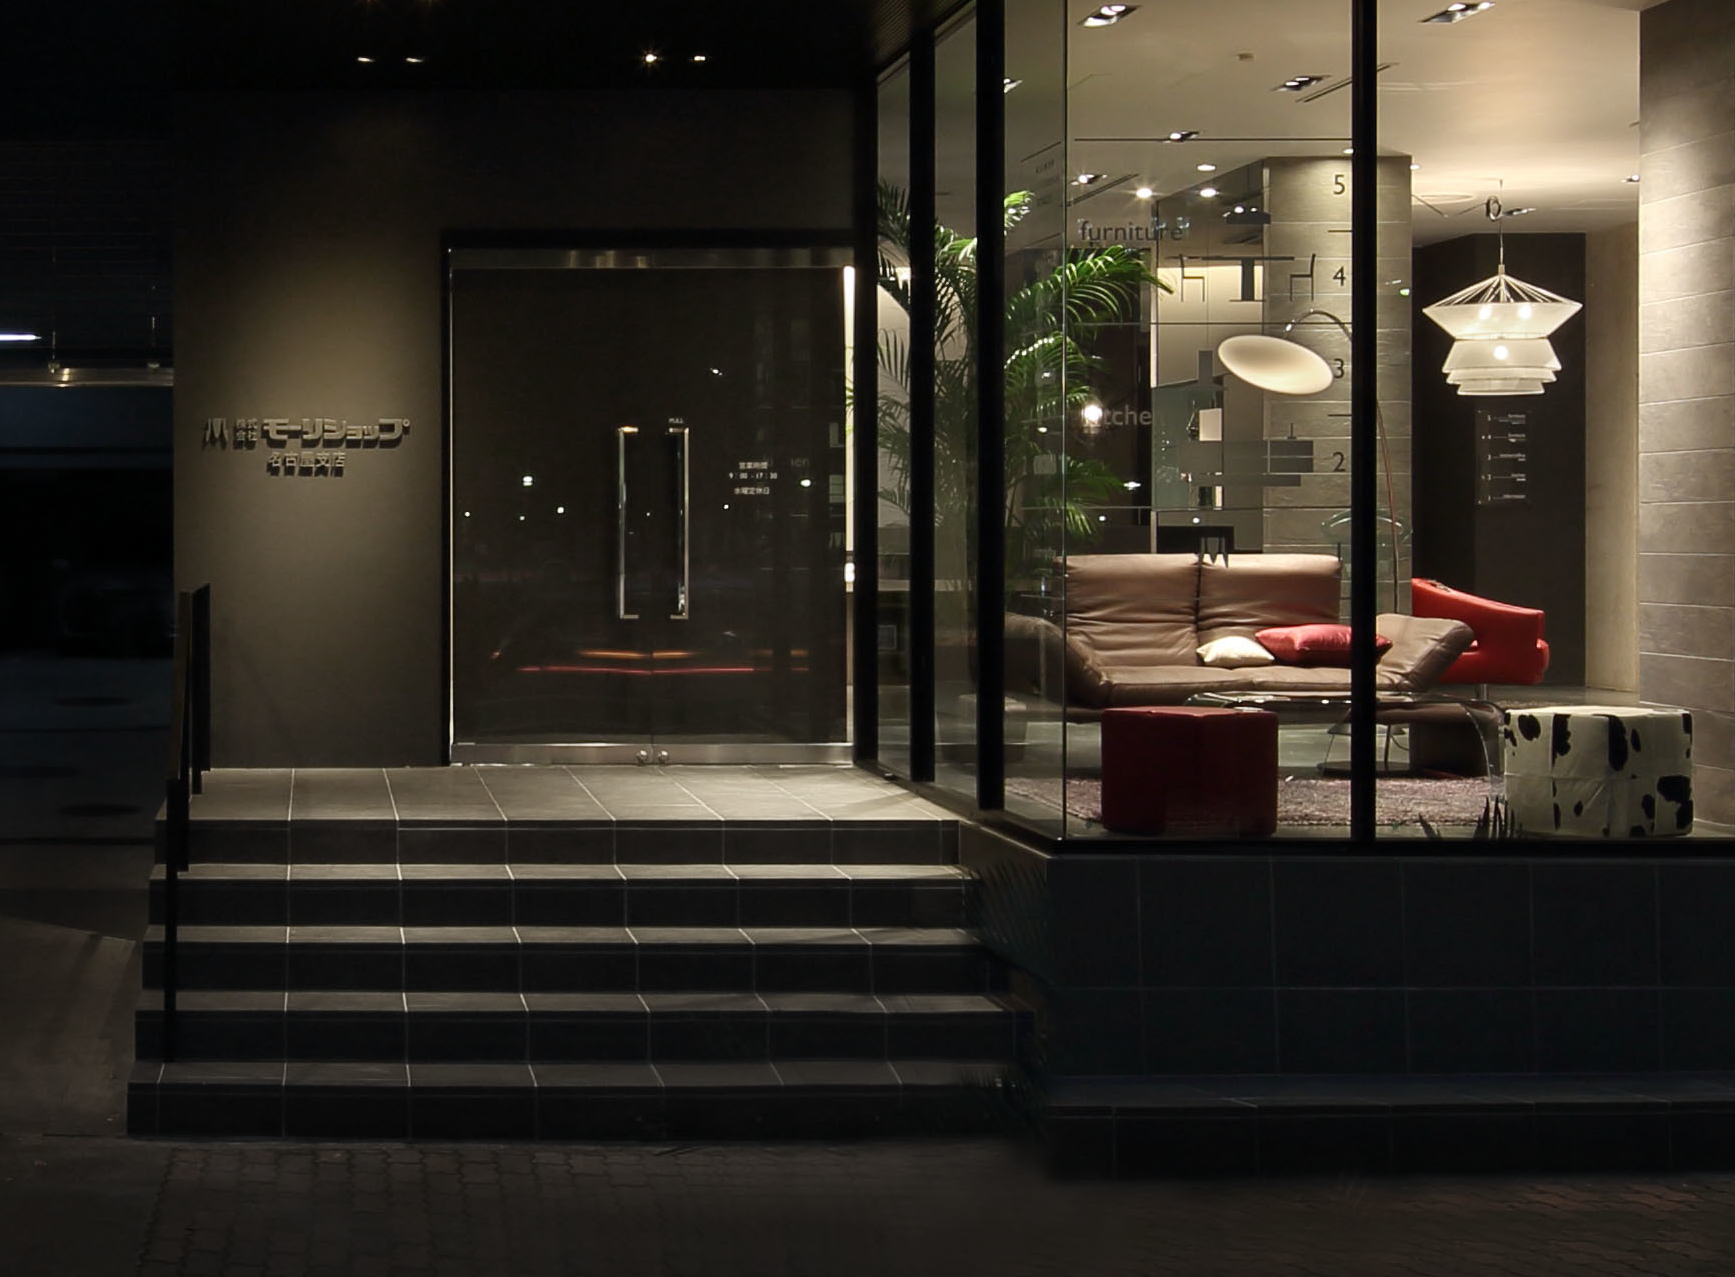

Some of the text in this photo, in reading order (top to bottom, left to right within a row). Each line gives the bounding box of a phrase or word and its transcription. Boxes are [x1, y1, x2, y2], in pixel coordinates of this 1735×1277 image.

[1332, 174, 1346, 195] 5
[1080, 220, 1184, 241] furniture
[1332, 266, 1346, 287] 4
[1333, 358, 1345, 379] 3
[1083, 404, 1153, 426] tche
[269, 451, 346, 468] 名古屋支店
[1332, 451, 1346, 472] 2
